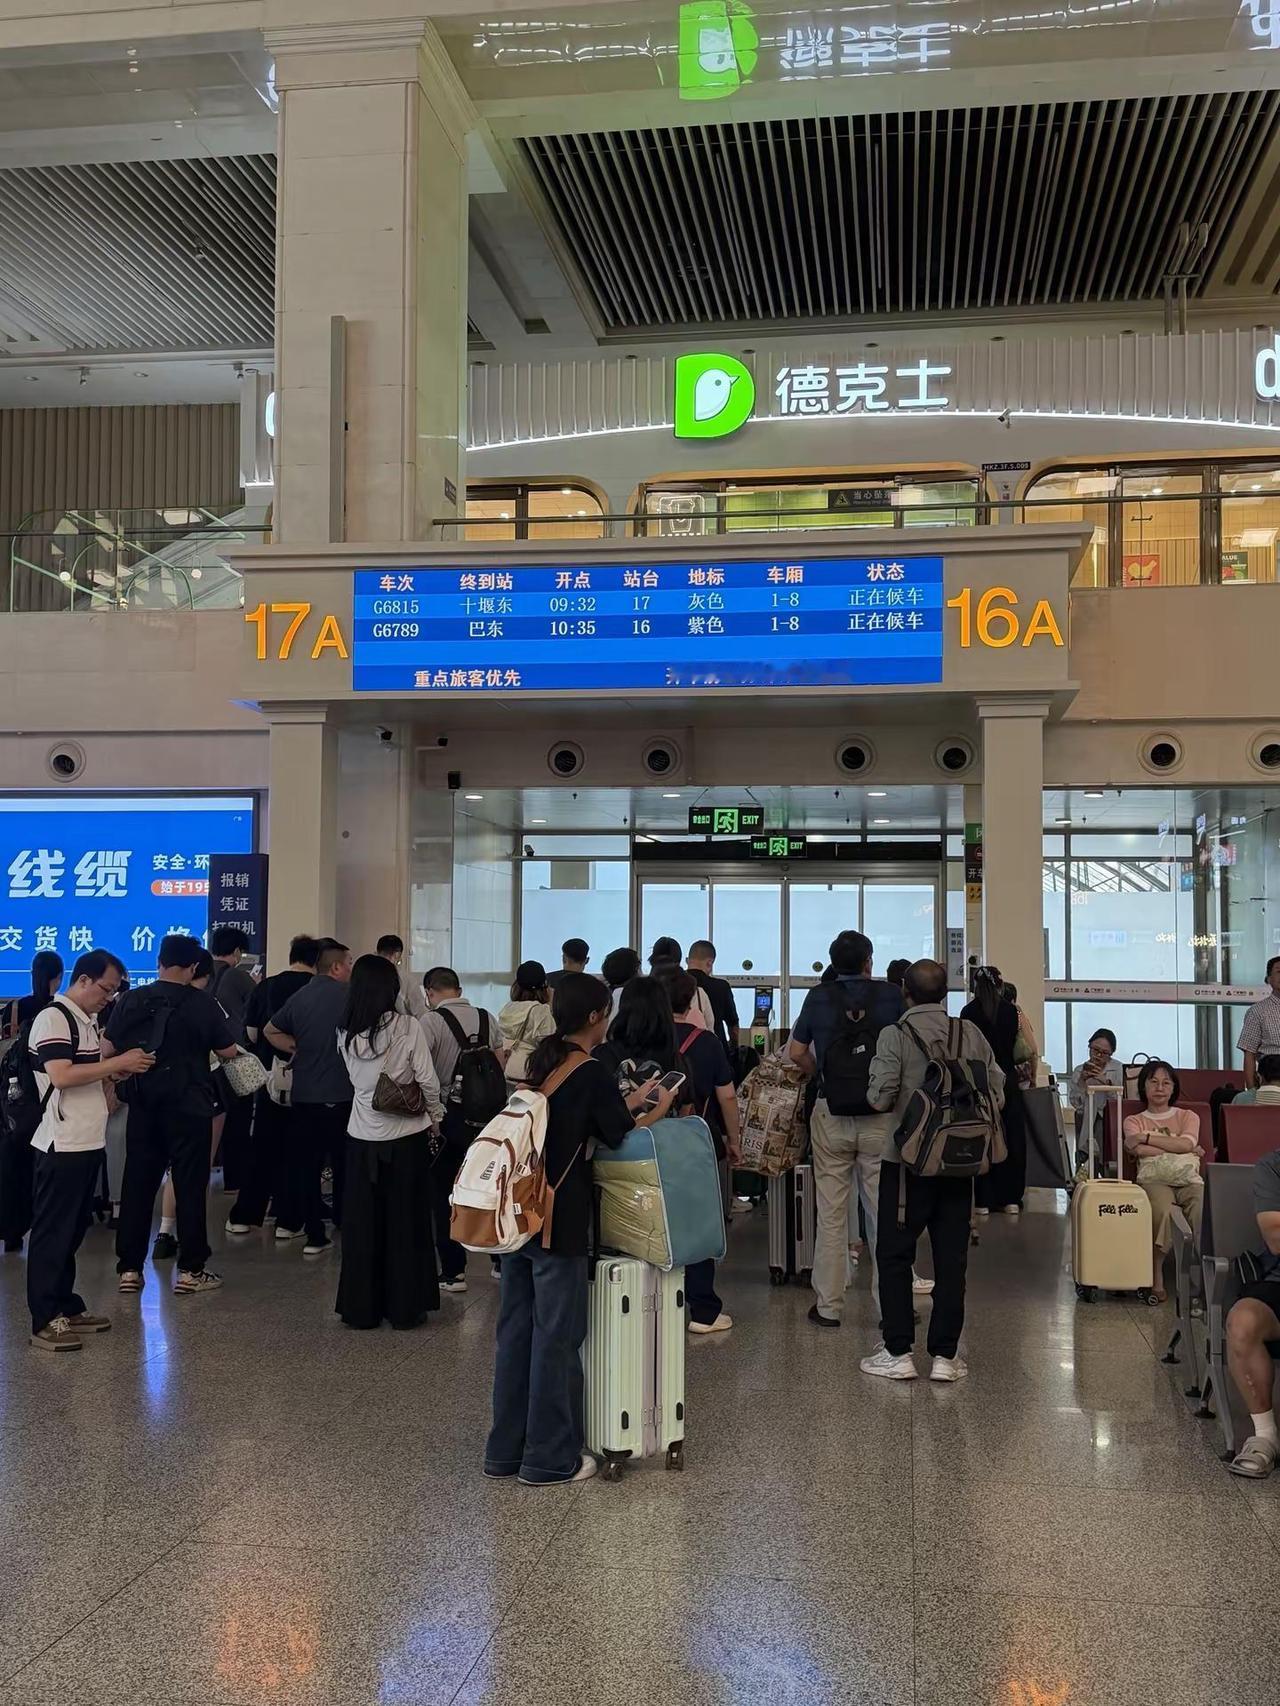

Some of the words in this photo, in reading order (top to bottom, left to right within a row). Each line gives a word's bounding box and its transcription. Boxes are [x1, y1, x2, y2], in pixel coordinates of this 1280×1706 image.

[775, 359, 952, 414] 德克士
[380, 574, 414, 592] 车次
[460, 573, 513, 591] 终到站
[555, 571, 591, 589] 开点
[624, 569, 659, 588] 站台
[688, 568, 725, 586] 地标
[767, 566, 804, 584] 车厢
[866, 563, 905, 581] 状态
[373, 600, 419, 614] G6815
[460, 597, 513, 614] 十堰东
[550, 597, 596, 612] 09:32
[632, 596, 650, 611] 17
[687, 592, 724, 610] 灰色
[771, 592, 800, 607] 1-8
[848, 587, 924, 607] 正在候车
[373, 623, 419, 637] G6789
[469, 621, 504, 638] 巴东
[550, 620, 596, 635] 10:35
[632, 619, 650, 634] 16
[687, 616, 724, 634] 紫色
[771, 617, 800, 631] 1-8
[848, 612, 924, 631] 正在候车
[947, 587, 1064, 647] 16A
[245, 603, 348, 659] 17A
[413, 669, 521, 688] 重点旅客优先
[742, 815, 759, 825] EXIT
[7, 849, 132, 897] 线缆
[221, 873, 249, 888] 报销
[221, 896, 249, 911] 凭证
[0, 926, 93, 952] 交货快
